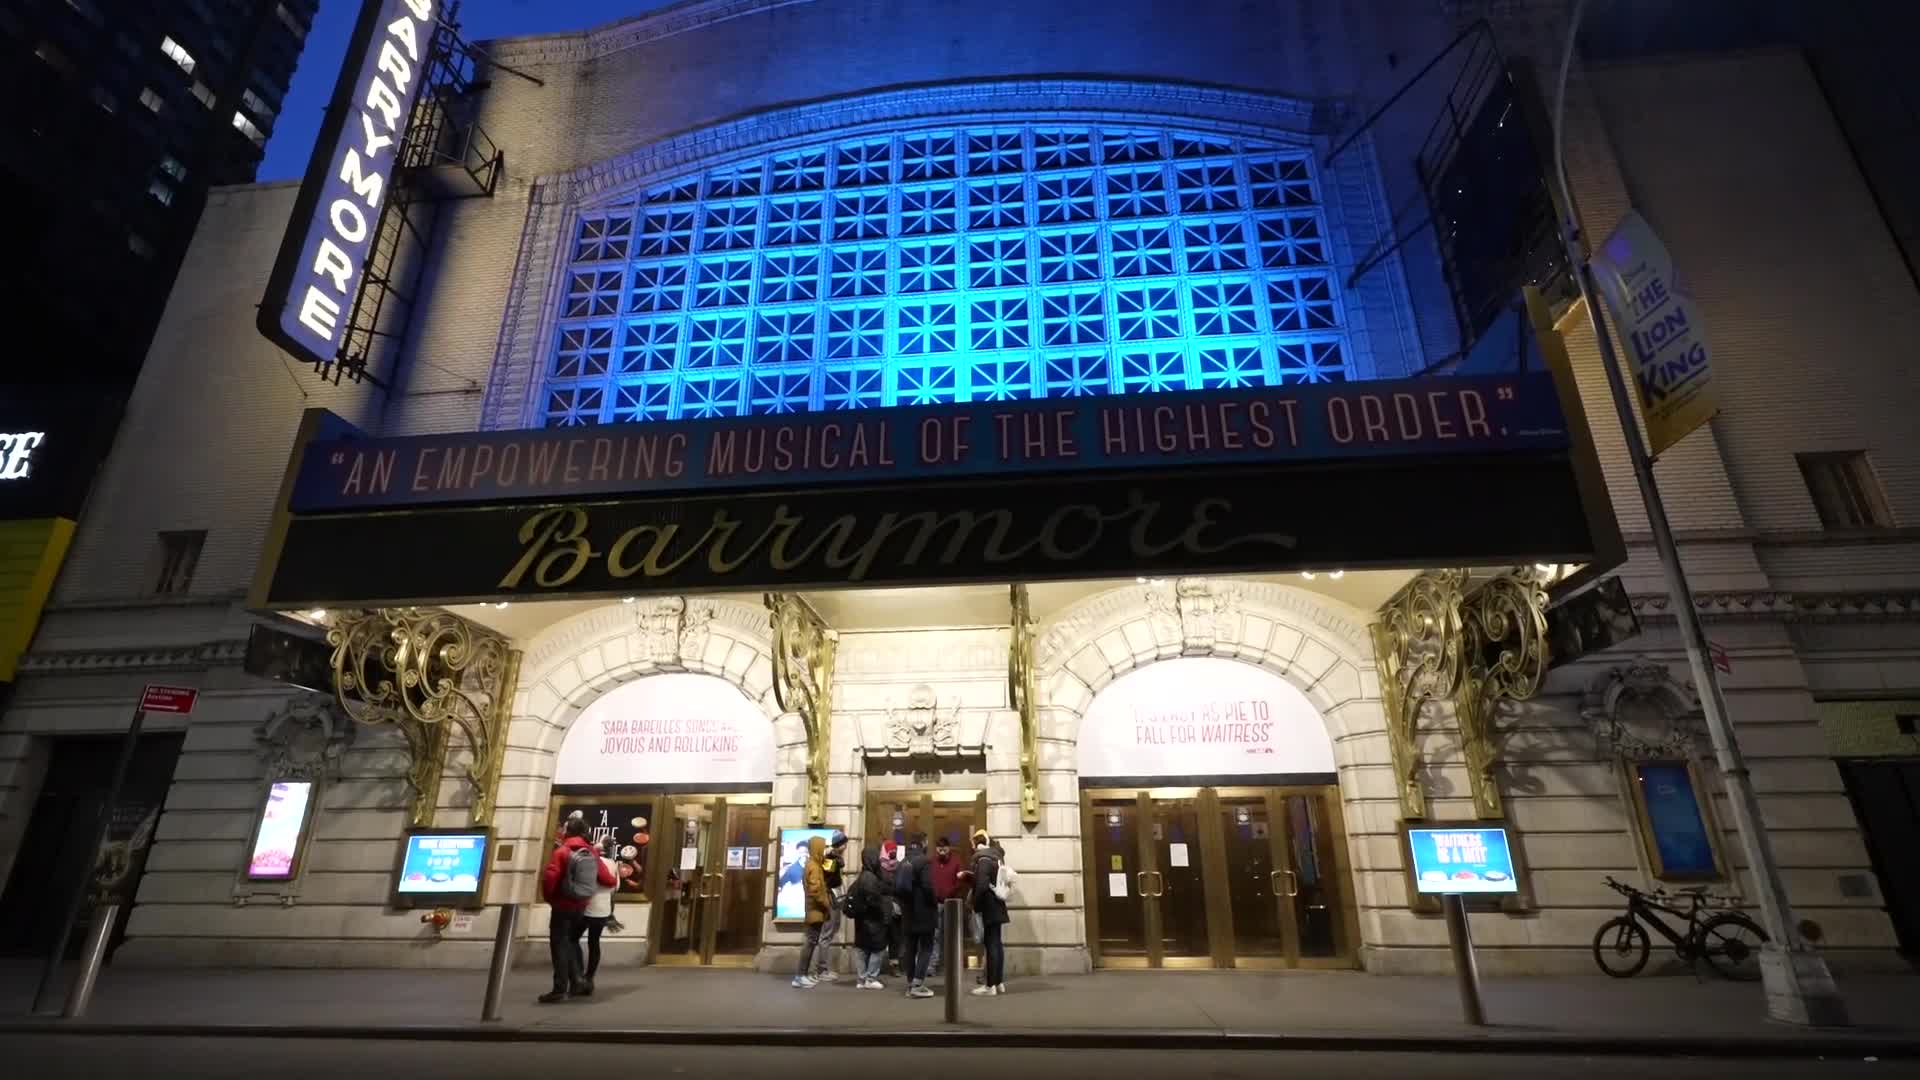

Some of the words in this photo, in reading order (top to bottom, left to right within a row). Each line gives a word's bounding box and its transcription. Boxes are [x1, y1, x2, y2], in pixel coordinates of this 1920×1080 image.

[411, 433, 687, 492] EMPOWERING
[708, 420, 894, 475] MUSICAL
[921, 416, 972, 464] OF
[996, 410, 1078, 460] THE
[1103, 399, 1299, 455] HIGHEST
[497, 488, 1297, 588] Barrymore
[1225, 700, 1248, 721] PIE
[1251, 699, 1269, 721] TO
[600, 736, 645, 754] JOYOUS
[647, 736, 671, 753] AND
[1136, 725, 1166, 744] FALL
[1170, 724, 1197, 744] FOR
